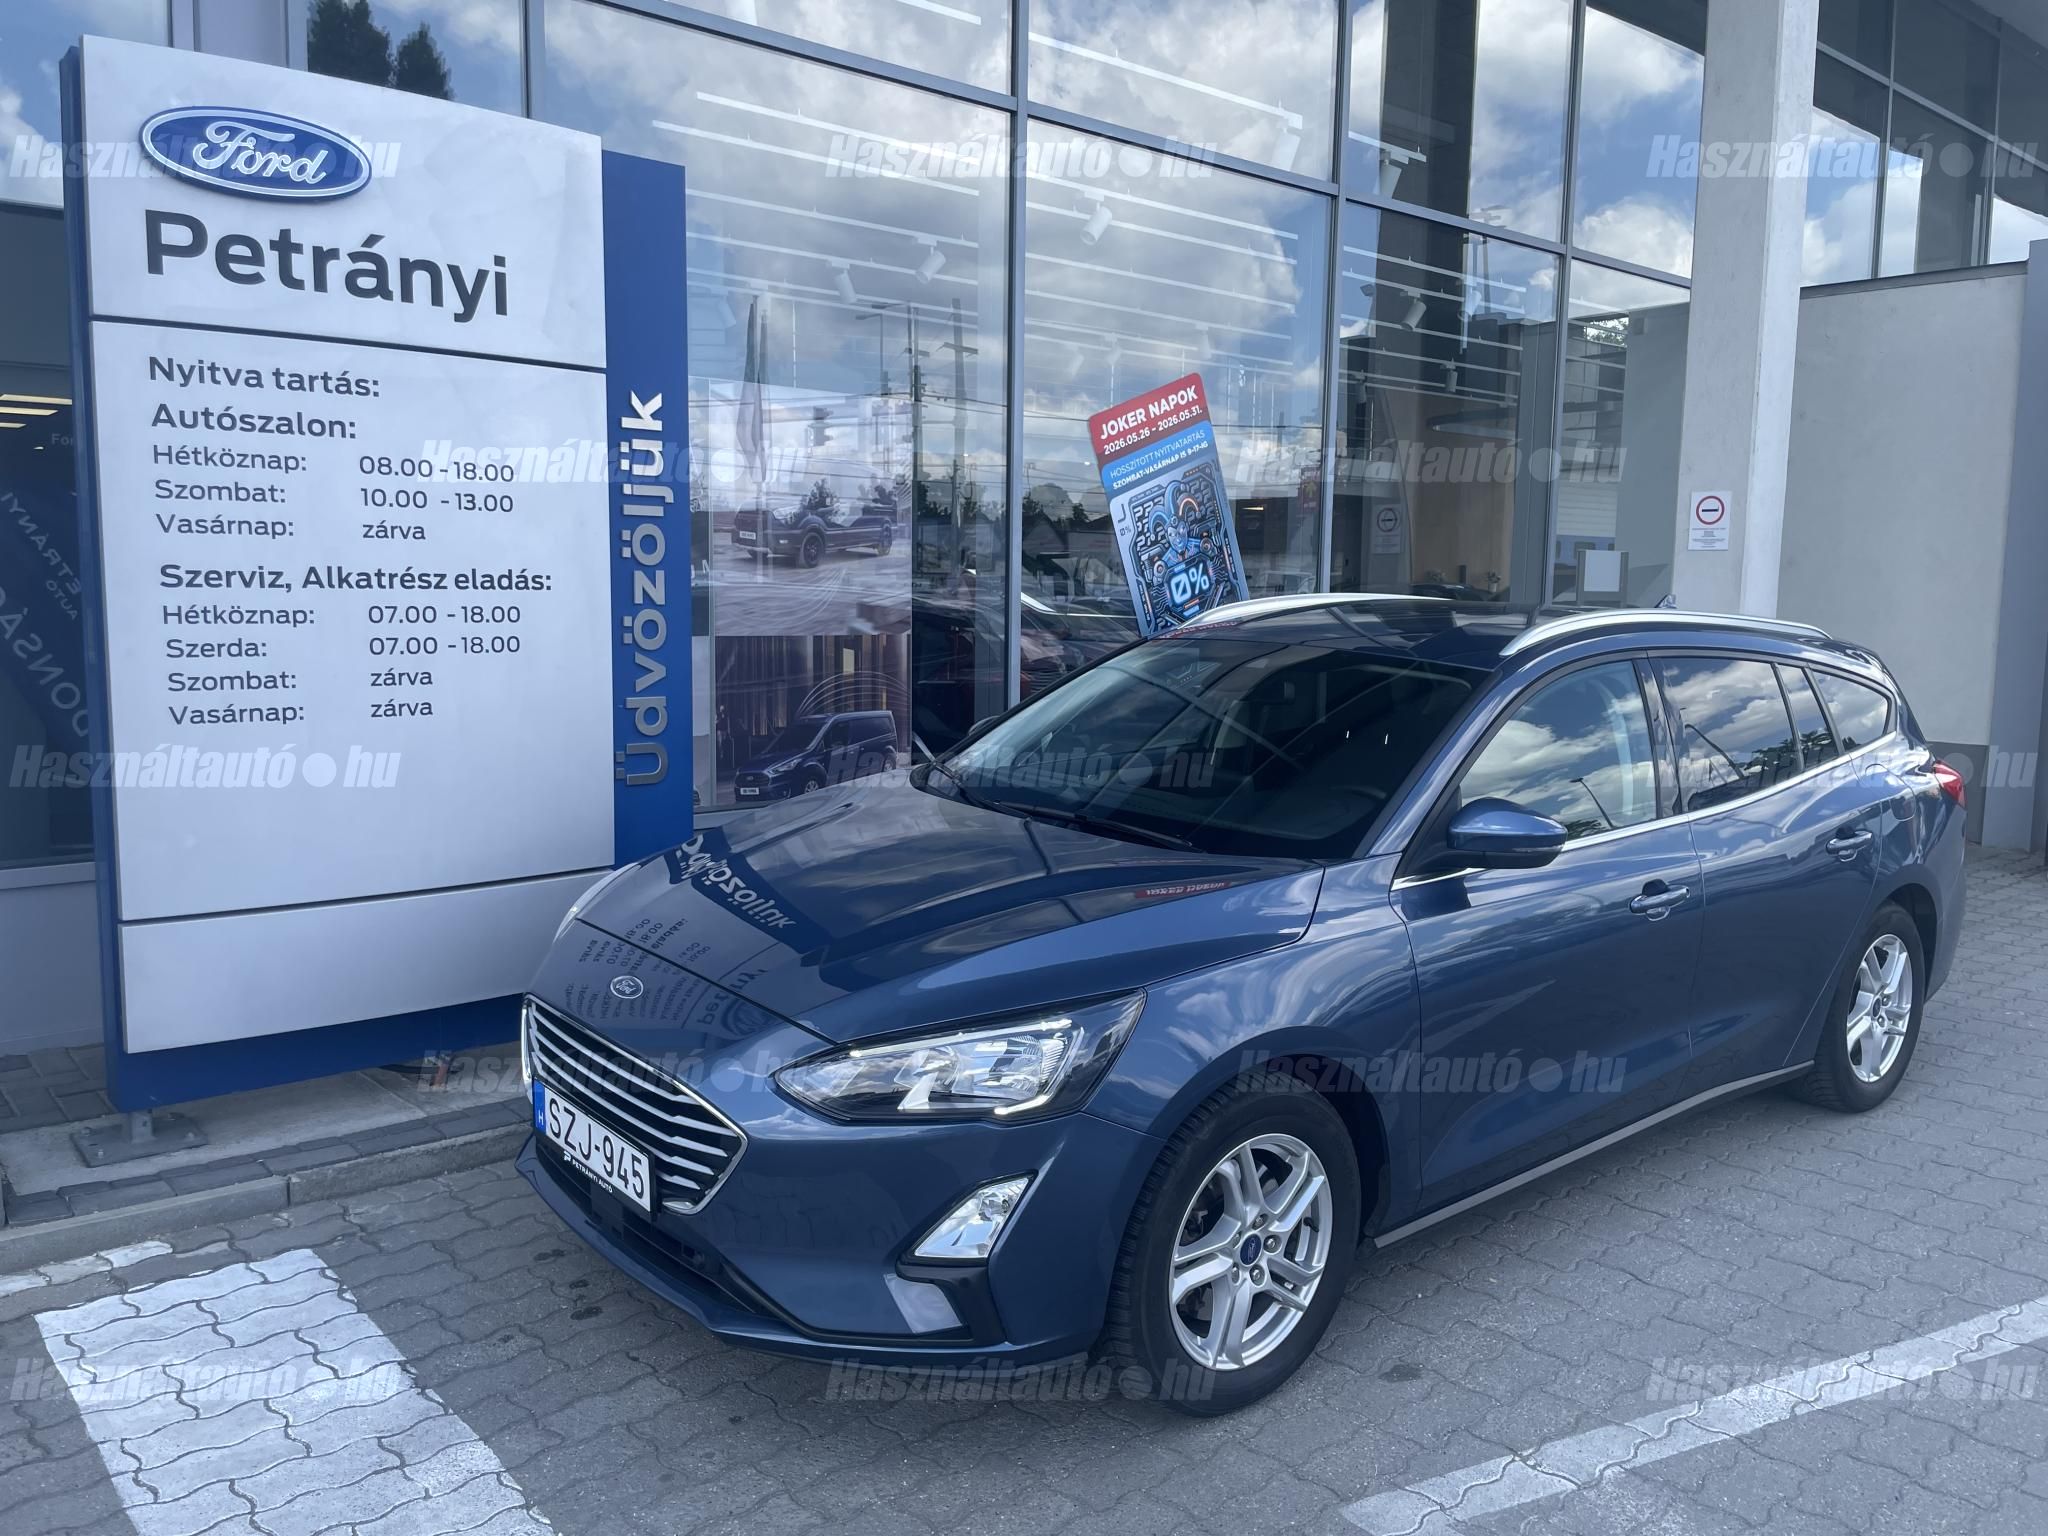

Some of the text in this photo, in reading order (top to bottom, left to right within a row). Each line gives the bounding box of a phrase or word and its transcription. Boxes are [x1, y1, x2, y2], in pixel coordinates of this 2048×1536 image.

[193, 119, 328, 186] Ford
[144, 209, 509, 323] Petrányi
[148, 356, 380, 397] Nyitva tartás:
[151, 404, 356, 438] Autószalon:
[1100, 385, 1198, 440] JOKER NAPOK
[51, 433, 73, 445] Fo
[1103, 427, 1151, 455] 2026.05.26
[153, 445, 307, 473] Hétköznap:
[359, 455, 433, 477] 08.00
[154, 479, 287, 504] Szombat:
[360, 488, 428, 509] 10.00
[156, 513, 426, 540] Vasárnap: zárva
[160, 564, 552, 593] Szerviz, Alkatrész eladás:
[615, 390, 674, 787] Üdvözöljük
[1170, 562, 1210, 605] 0%
[163, 604, 315, 628] Hétköznap:
[368, 605, 438, 625] 07.00
[166, 637, 268, 658] Szerda:
[369, 635, 438, 655] 07.00
[167, 667, 433, 691] Szombat: zárva
[168, 699, 433, 725] Vasárnap: zárva
[537, 1097, 645, 1200] H SZJ-945
